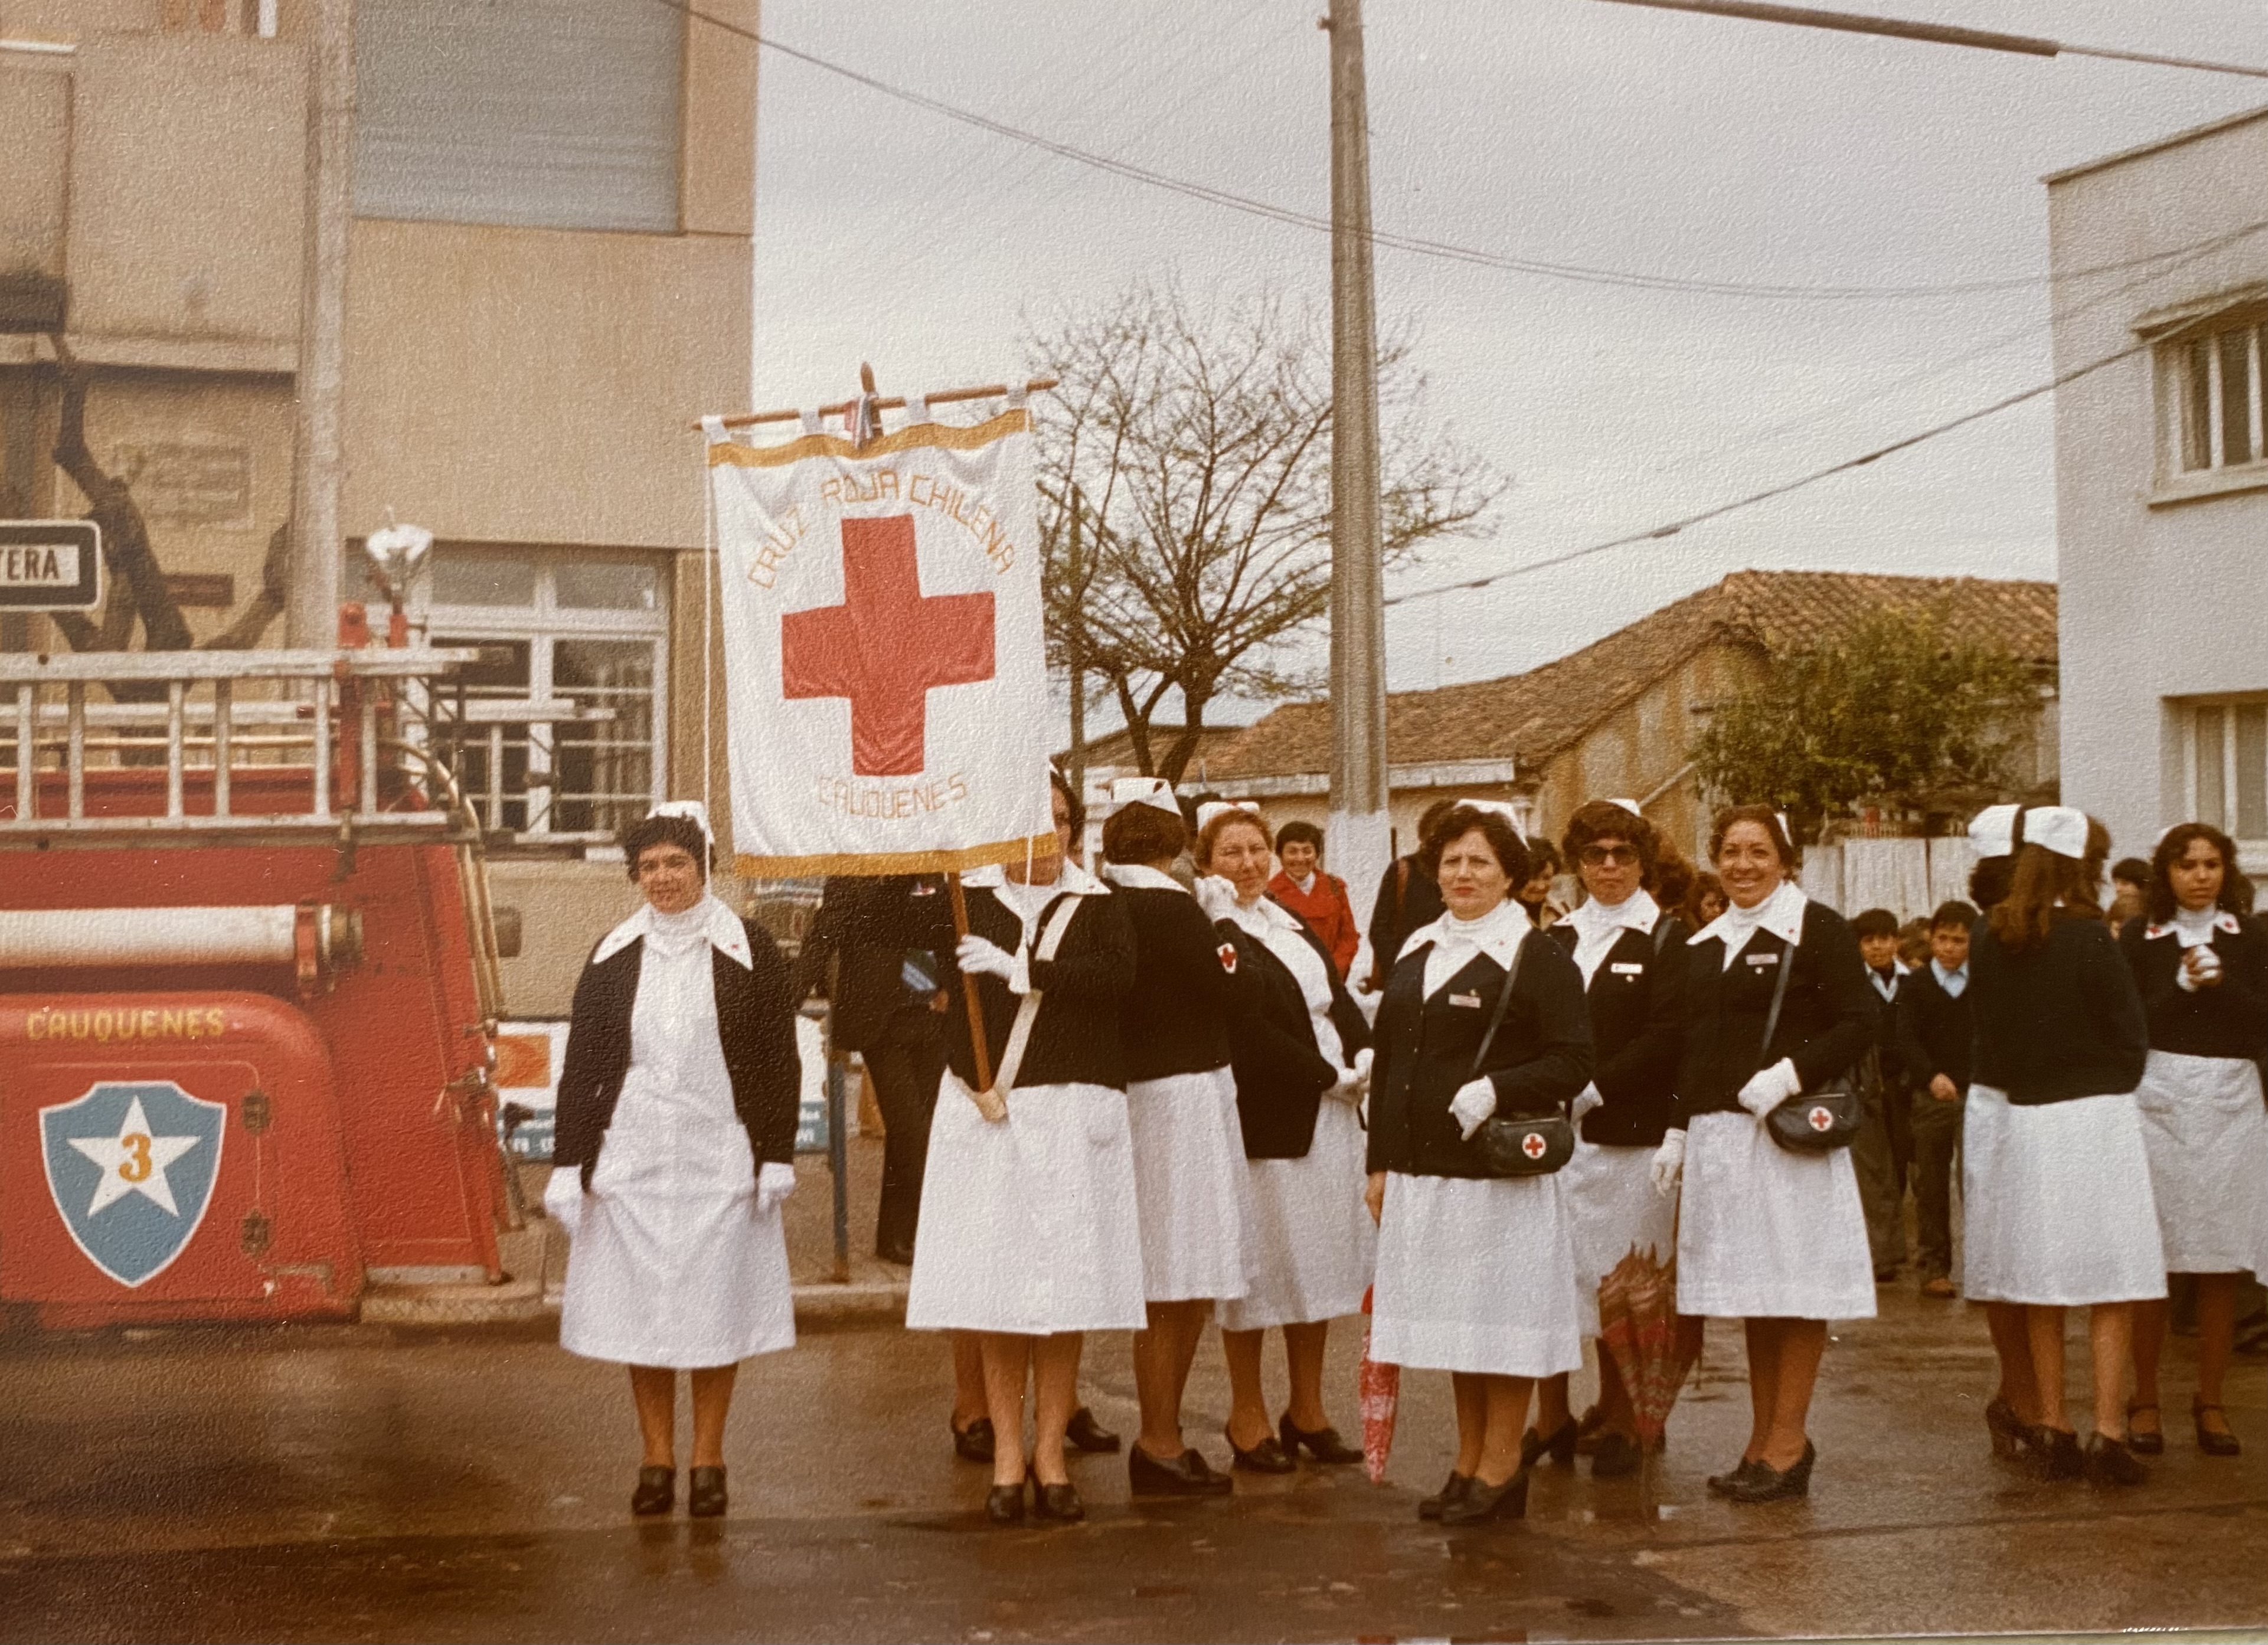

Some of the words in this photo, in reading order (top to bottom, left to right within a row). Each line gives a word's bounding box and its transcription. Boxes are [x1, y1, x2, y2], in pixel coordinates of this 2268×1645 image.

[747, 506, 809, 590] CRUZ
[820, 470, 900, 505] ROJA
[909, 474, 1014, 575] CHILENA
[27, 1008, 224, 1042] CAUQUENES
[119, 1132, 152, 1182] 3
